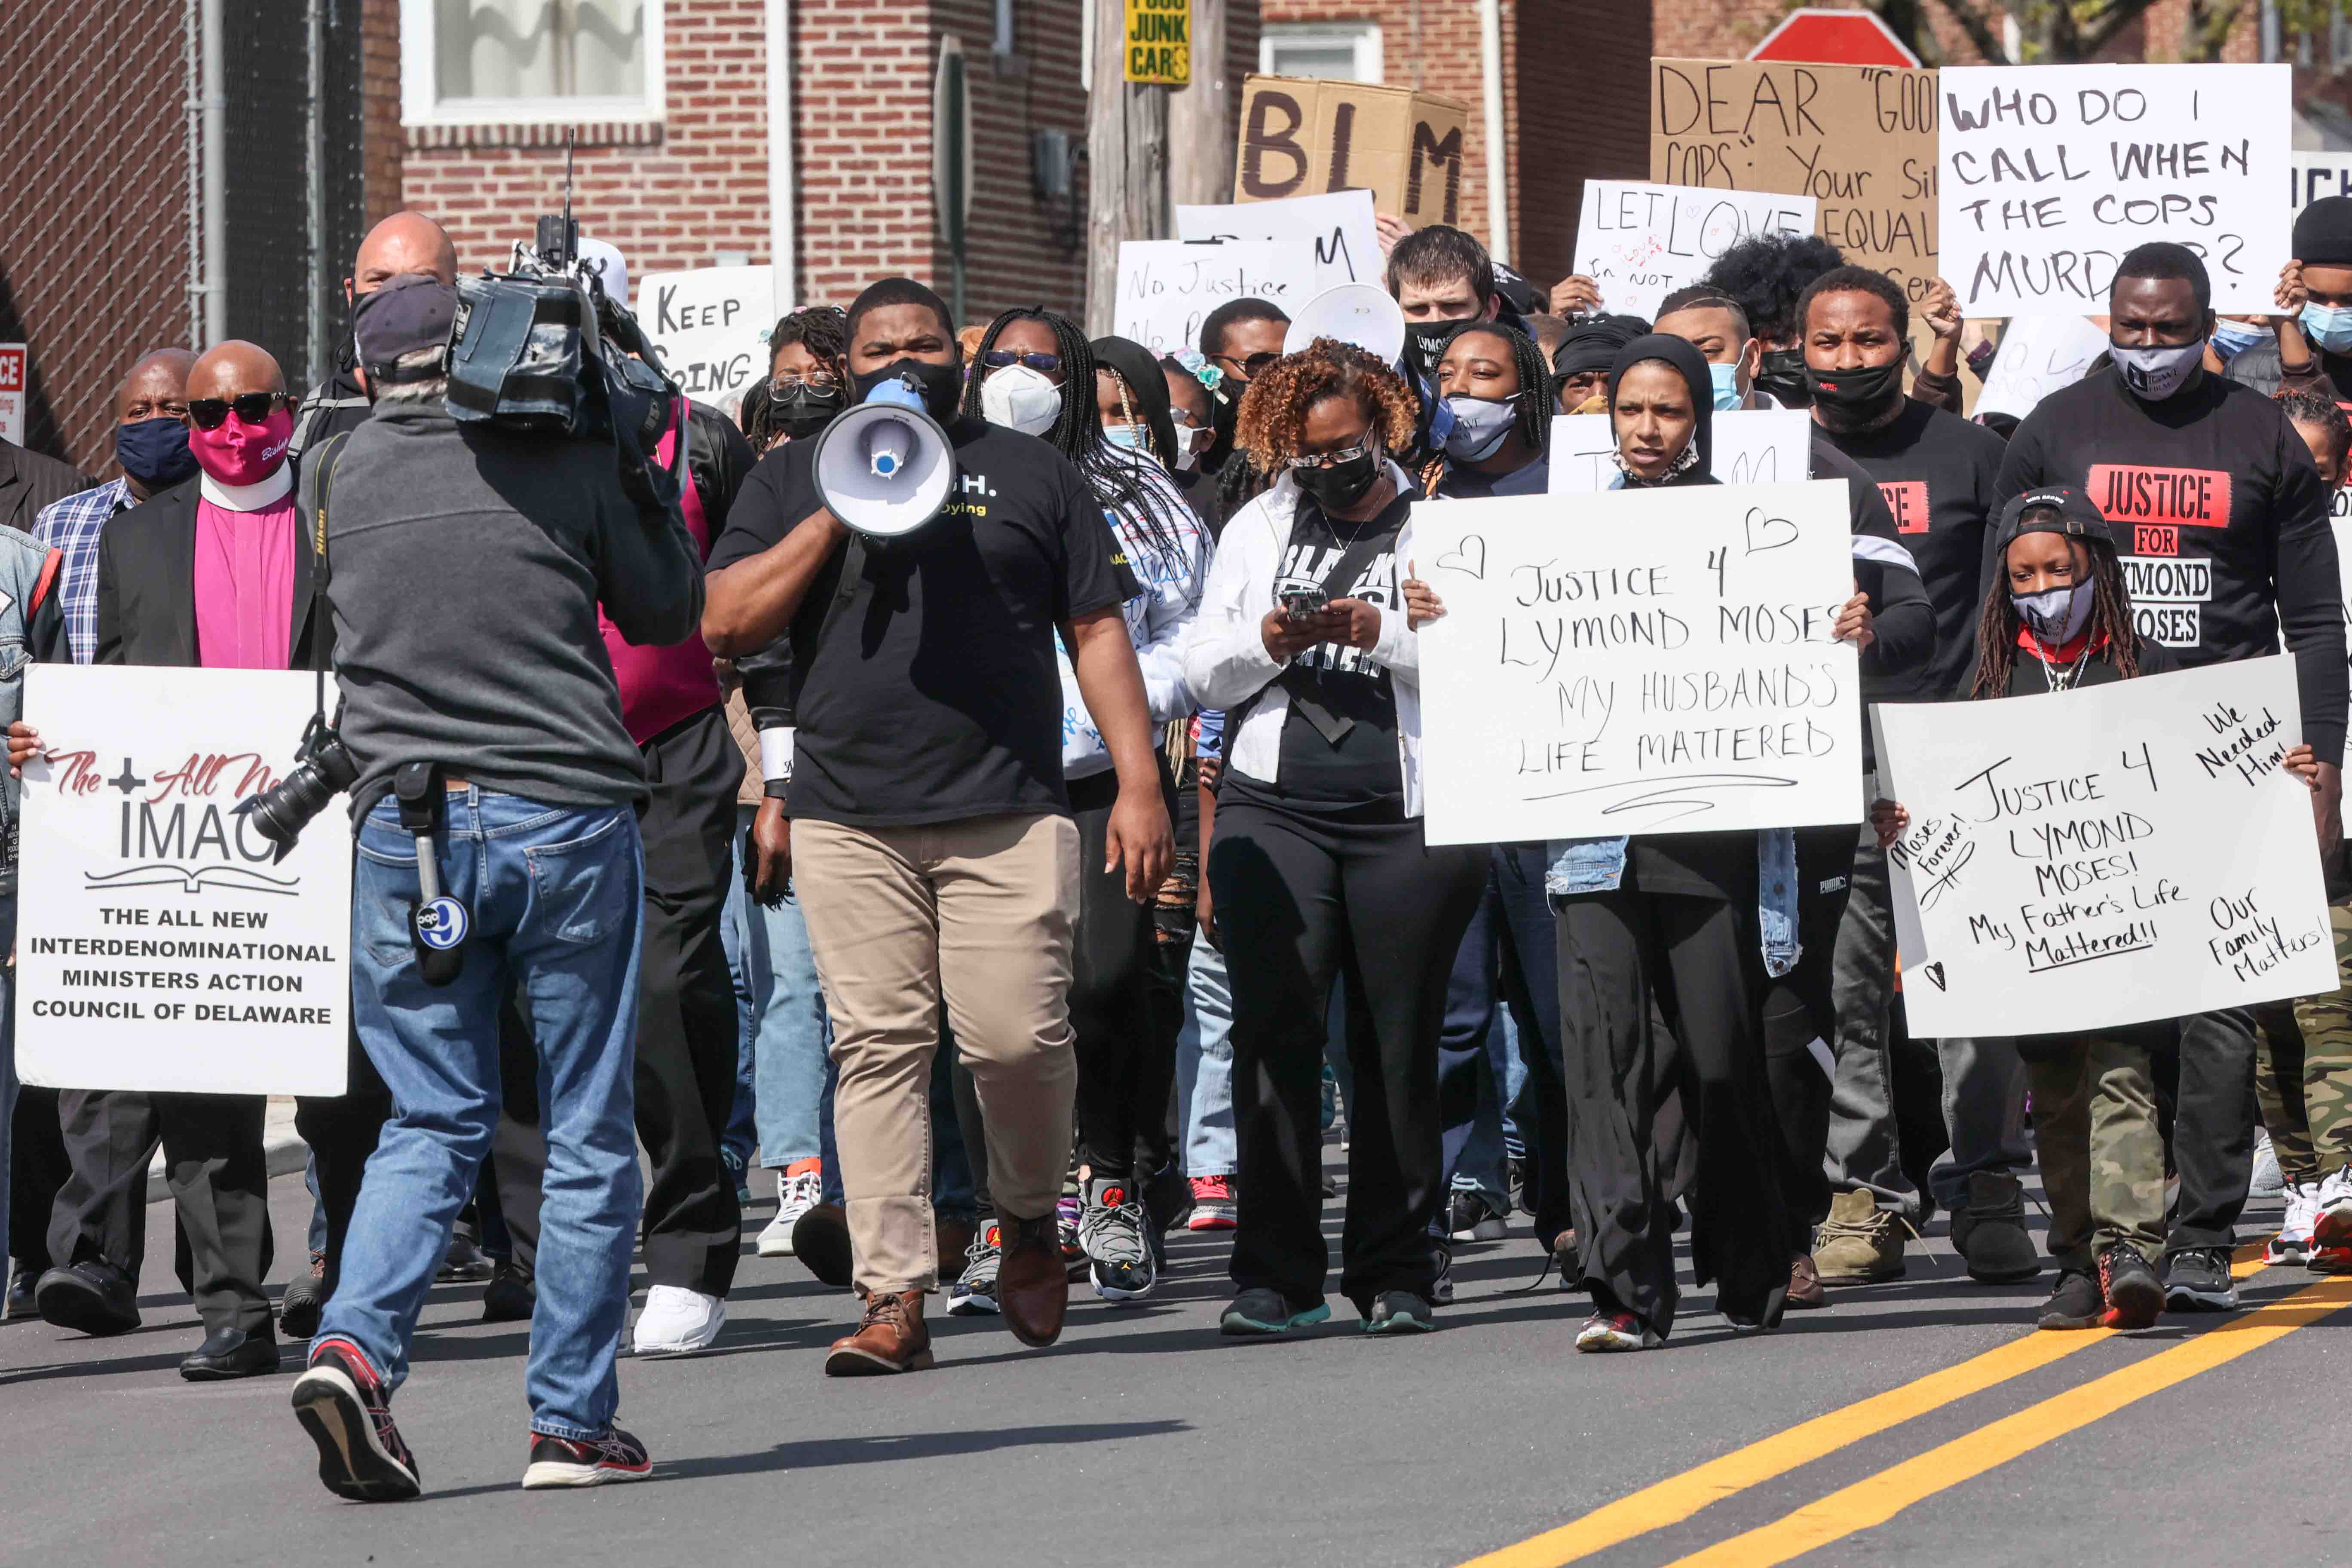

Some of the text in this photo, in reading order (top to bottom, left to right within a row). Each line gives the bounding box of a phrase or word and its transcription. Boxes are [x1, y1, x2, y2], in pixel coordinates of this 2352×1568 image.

[1130, 14, 1186, 42] JUNK
[1132, 46, 1188, 80] CARS
[1659, 65, 1939, 137] DEAR "GOO
[1947, 86, 2198, 132] WHO DO I
[1240, 90, 1462, 225] BLM
[1786, 144, 1872, 200] Your
[1902, 159, 1937, 200] Sil
[1951, 138, 2249, 185] CALL WHEN
[1597, 187, 1664, 230] LET
[1960, 194, 2217, 232] THE COPS
[1128, 258, 1289, 300] No Justice
[1629, 273, 1673, 288] NOT
[1969, 233, 2244, 304] MURD?
[658, 284, 741, 335] KEEP
[2104, 470, 2212, 520] JUSTICE
[316, 509, 325, 556] Nikon
[2137, 527, 2175, 554] FOR
[1510, 546, 1727, 607] JUSTICE 4
[1501, 608, 1689, 684] LYMOND
[1558, 663, 1838, 743] MY HUSBAND'S
[2202, 702, 2248, 734] We
[1519, 716, 1834, 774] LIFE MATTERED
[2195, 707, 2282, 779] Needed
[44, 748, 102, 796] The
[145, 753, 228, 804] All
[1954, 742, 2158, 822] JUSTICE 4
[1891, 818, 1942, 870] Moses
[1917, 813, 1972, 876] Forever!
[2009, 811, 2153, 861] LYMOND
[2035, 851, 2138, 897] MOSES!
[99, 908, 269, 929] THE ALL NEW
[1968, 878, 2190, 951] My Father's Life
[2210, 887, 2257, 931] Our
[31, 937, 336, 962] INTERDENOMINATIONAL
[2025, 920, 2158, 967] Mattered!!
[2208, 916, 2280, 966] Family
[62, 969, 303, 992] MINISTERS ACTION
[32, 1000, 331, 1025] COUNCIL OF DELAWARE
